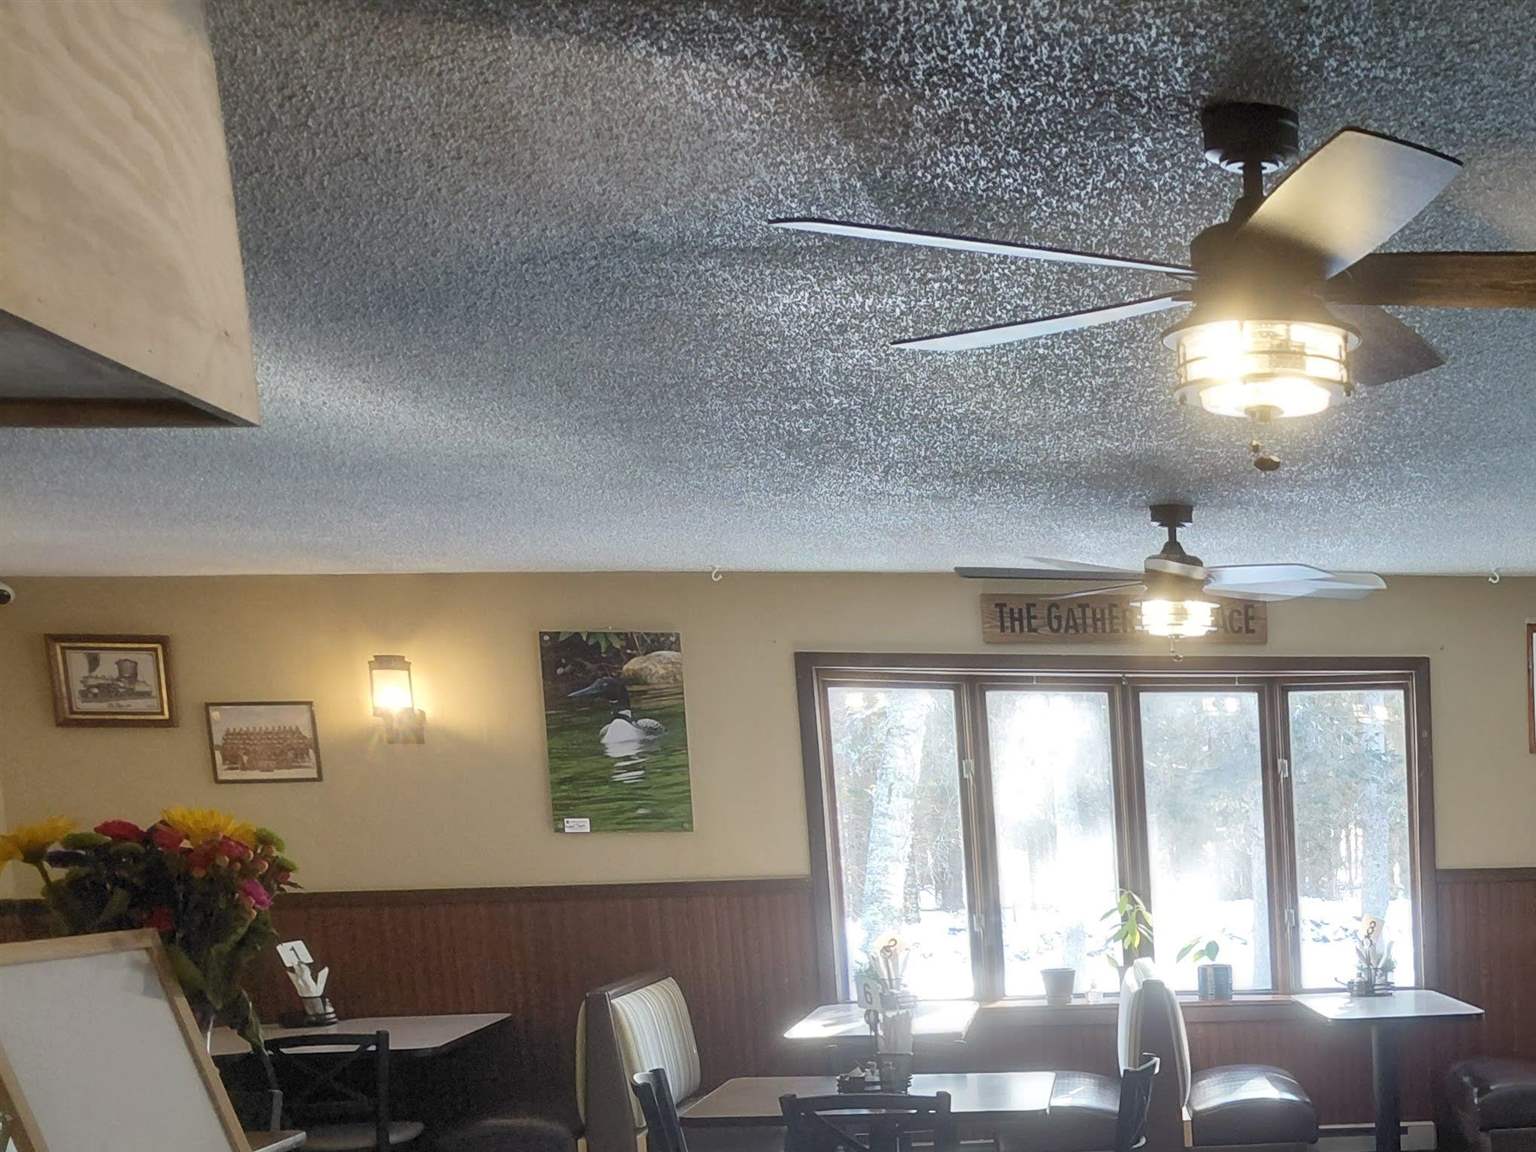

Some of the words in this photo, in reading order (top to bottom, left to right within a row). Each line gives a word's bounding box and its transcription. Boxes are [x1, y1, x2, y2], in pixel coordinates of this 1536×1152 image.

[994, 602, 1038, 634] THE
[1046, 602, 1138, 634] GATHER
[1211, 603, 1256, 634] ACE
[289, 946, 301, 961] 1
[863, 982, 873, 1005] 6
